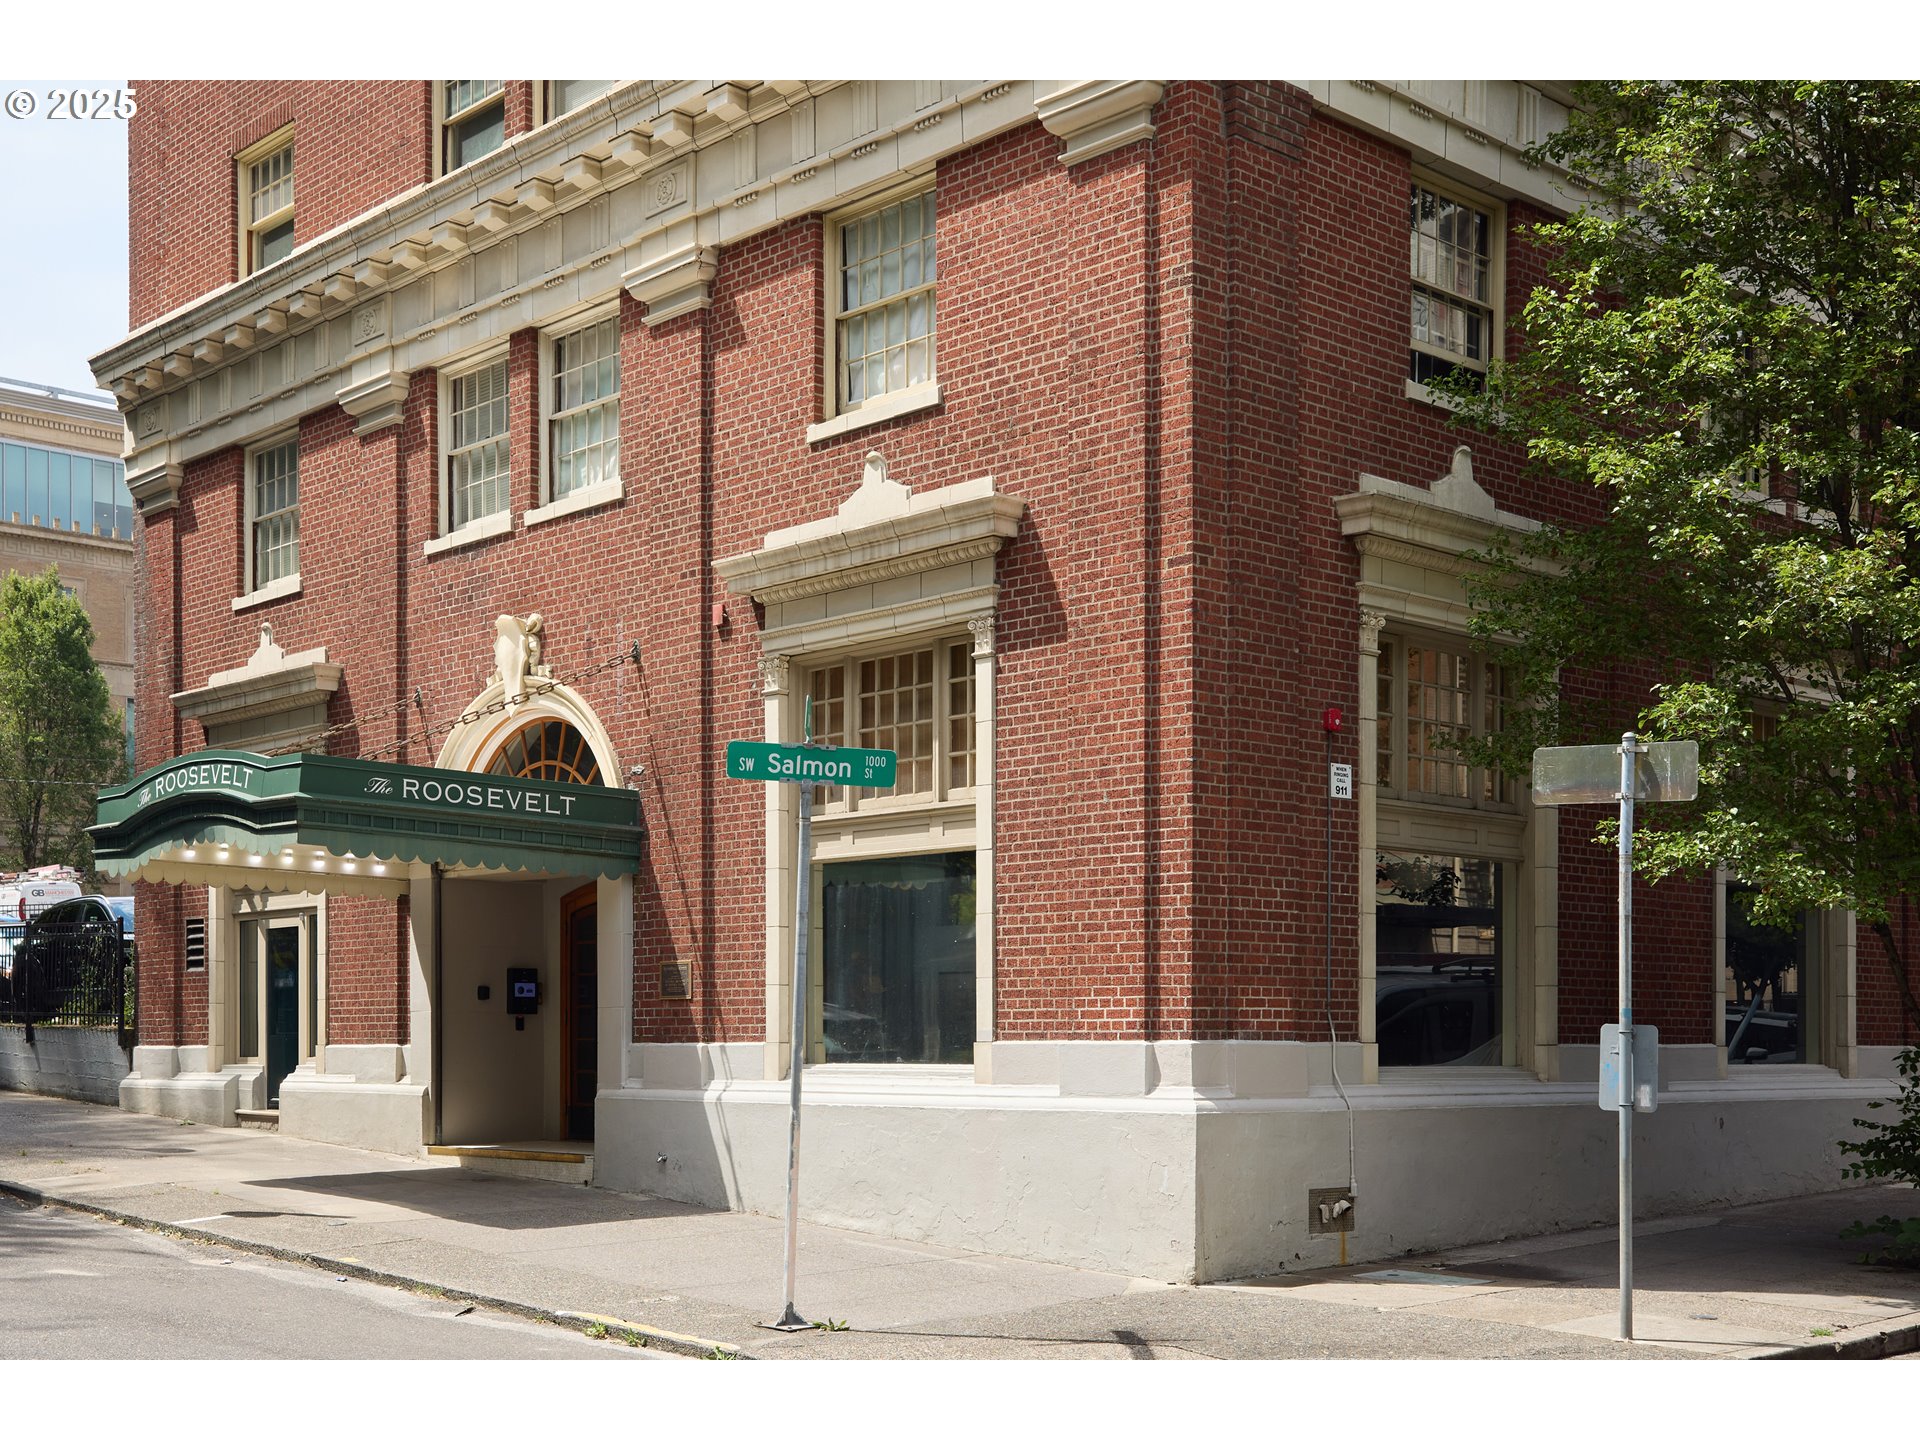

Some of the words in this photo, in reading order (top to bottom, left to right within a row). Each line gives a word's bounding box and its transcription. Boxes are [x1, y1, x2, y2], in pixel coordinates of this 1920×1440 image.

[738, 757, 755, 771] SW
[767, 753, 851, 778] Salmon
[865, 756, 886, 767] 1000
[864, 768, 873, 779] St
[137, 787, 151, 808] The
[155, 764, 253, 798] ROOSEVELT
[1335, 785, 1347, 795] 911
[364, 777, 393, 795] The
[402, 778, 576, 815] ROOSEVELT
[31, 889, 45, 897] GB
